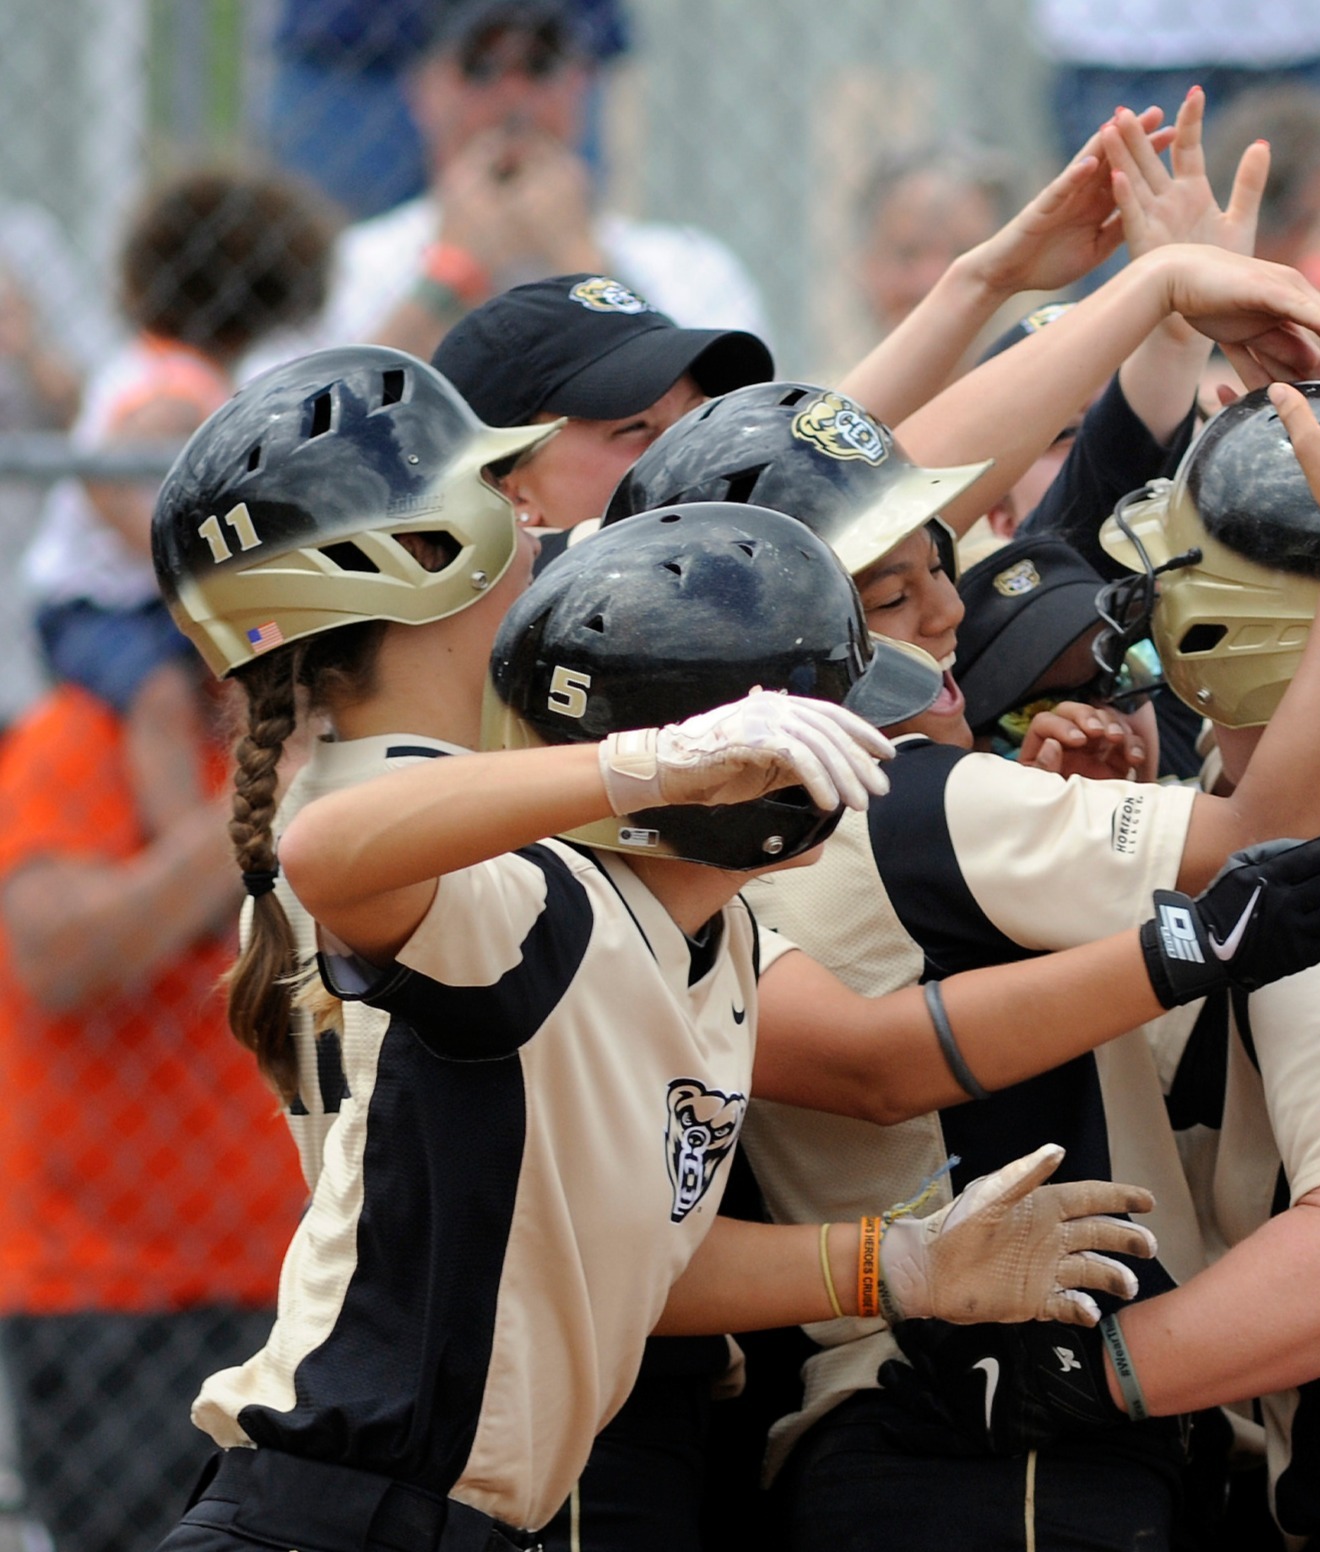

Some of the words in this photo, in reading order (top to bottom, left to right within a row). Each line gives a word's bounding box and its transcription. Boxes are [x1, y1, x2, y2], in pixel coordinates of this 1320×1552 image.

[198, 502, 263, 564] 11
[548, 665, 591, 719] 5
[1116, 797, 1135, 854] HORIZON
[862, 1234, 876, 1274] HEROES
